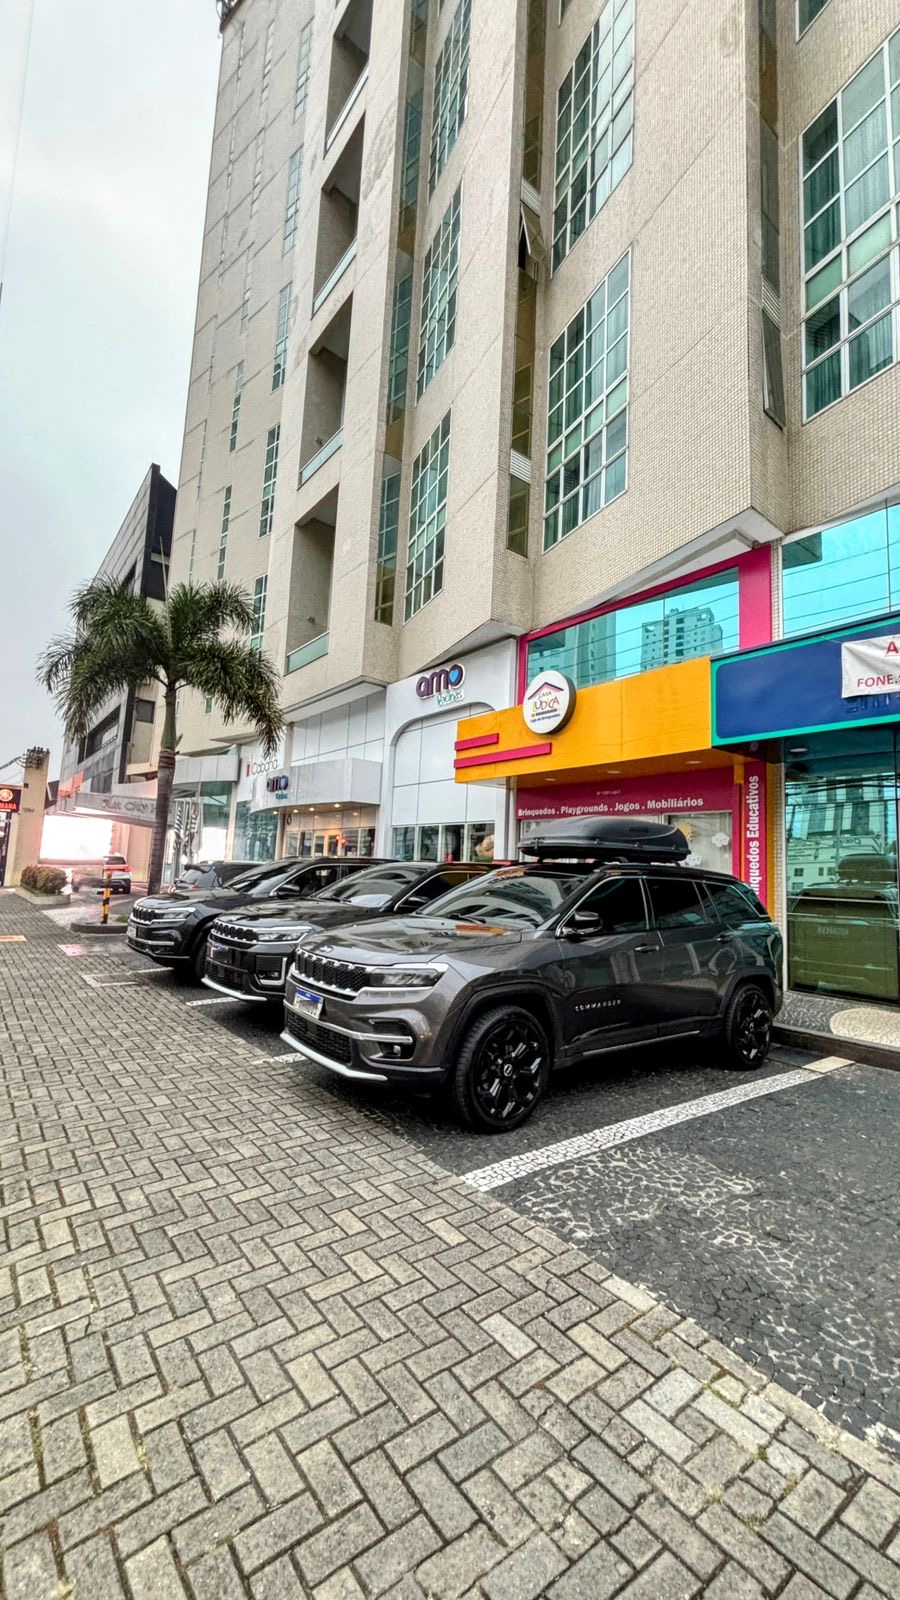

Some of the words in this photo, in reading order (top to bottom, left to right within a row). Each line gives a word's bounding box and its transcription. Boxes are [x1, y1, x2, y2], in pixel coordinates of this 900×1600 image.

[416, 663, 464, 698] amo
[518, 808, 556, 817] Brinquedos
[561, 803, 608, 815] Playgrounds
[614, 802, 640, 812] Jogos
[647, 797, 704, 809] Mobiliários
[746, 775, 760, 838] Educativos
